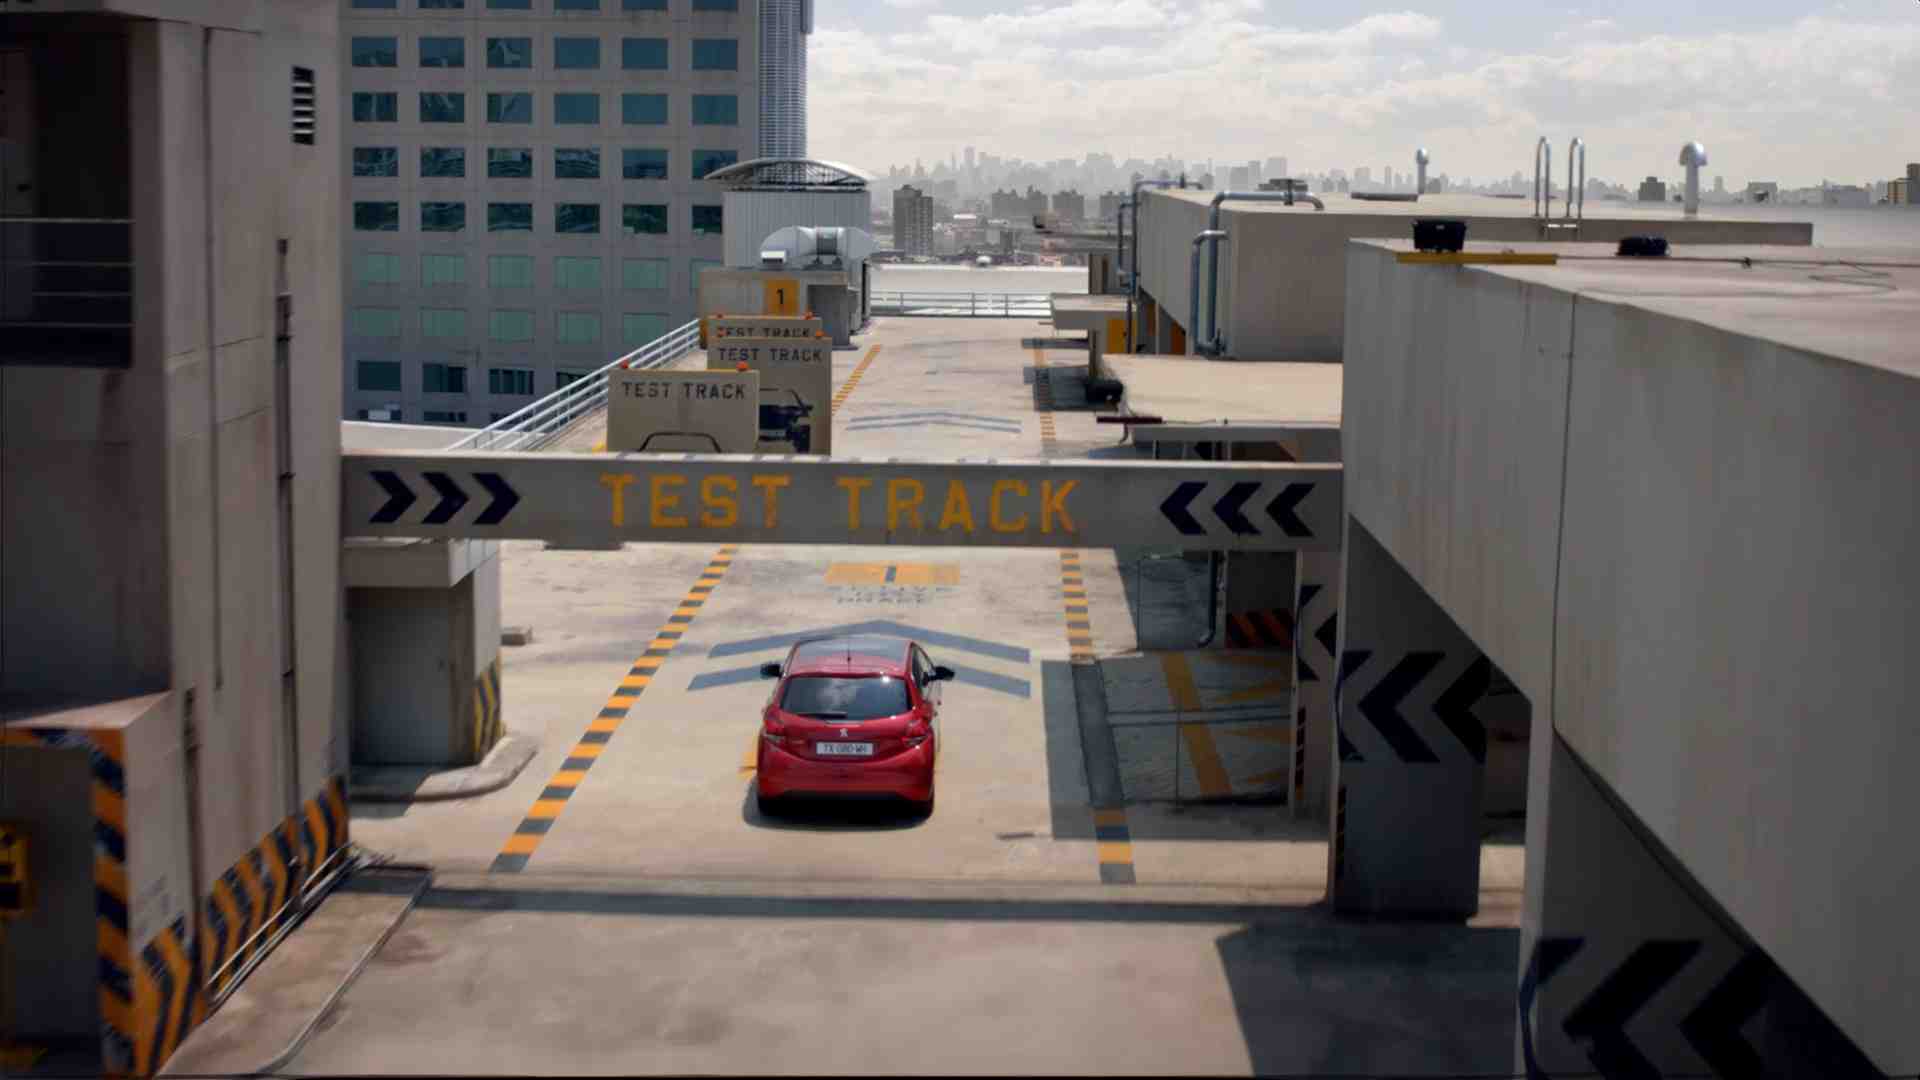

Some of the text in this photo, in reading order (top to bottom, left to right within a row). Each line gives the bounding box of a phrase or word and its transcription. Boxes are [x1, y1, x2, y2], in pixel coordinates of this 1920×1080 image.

[776, 288, 784, 304] 1
[718, 347, 822, 361] TEST TRACK
[622, 382, 746, 399] TEST TRACK
[600, 474, 1080, 534] TEST TRACK
